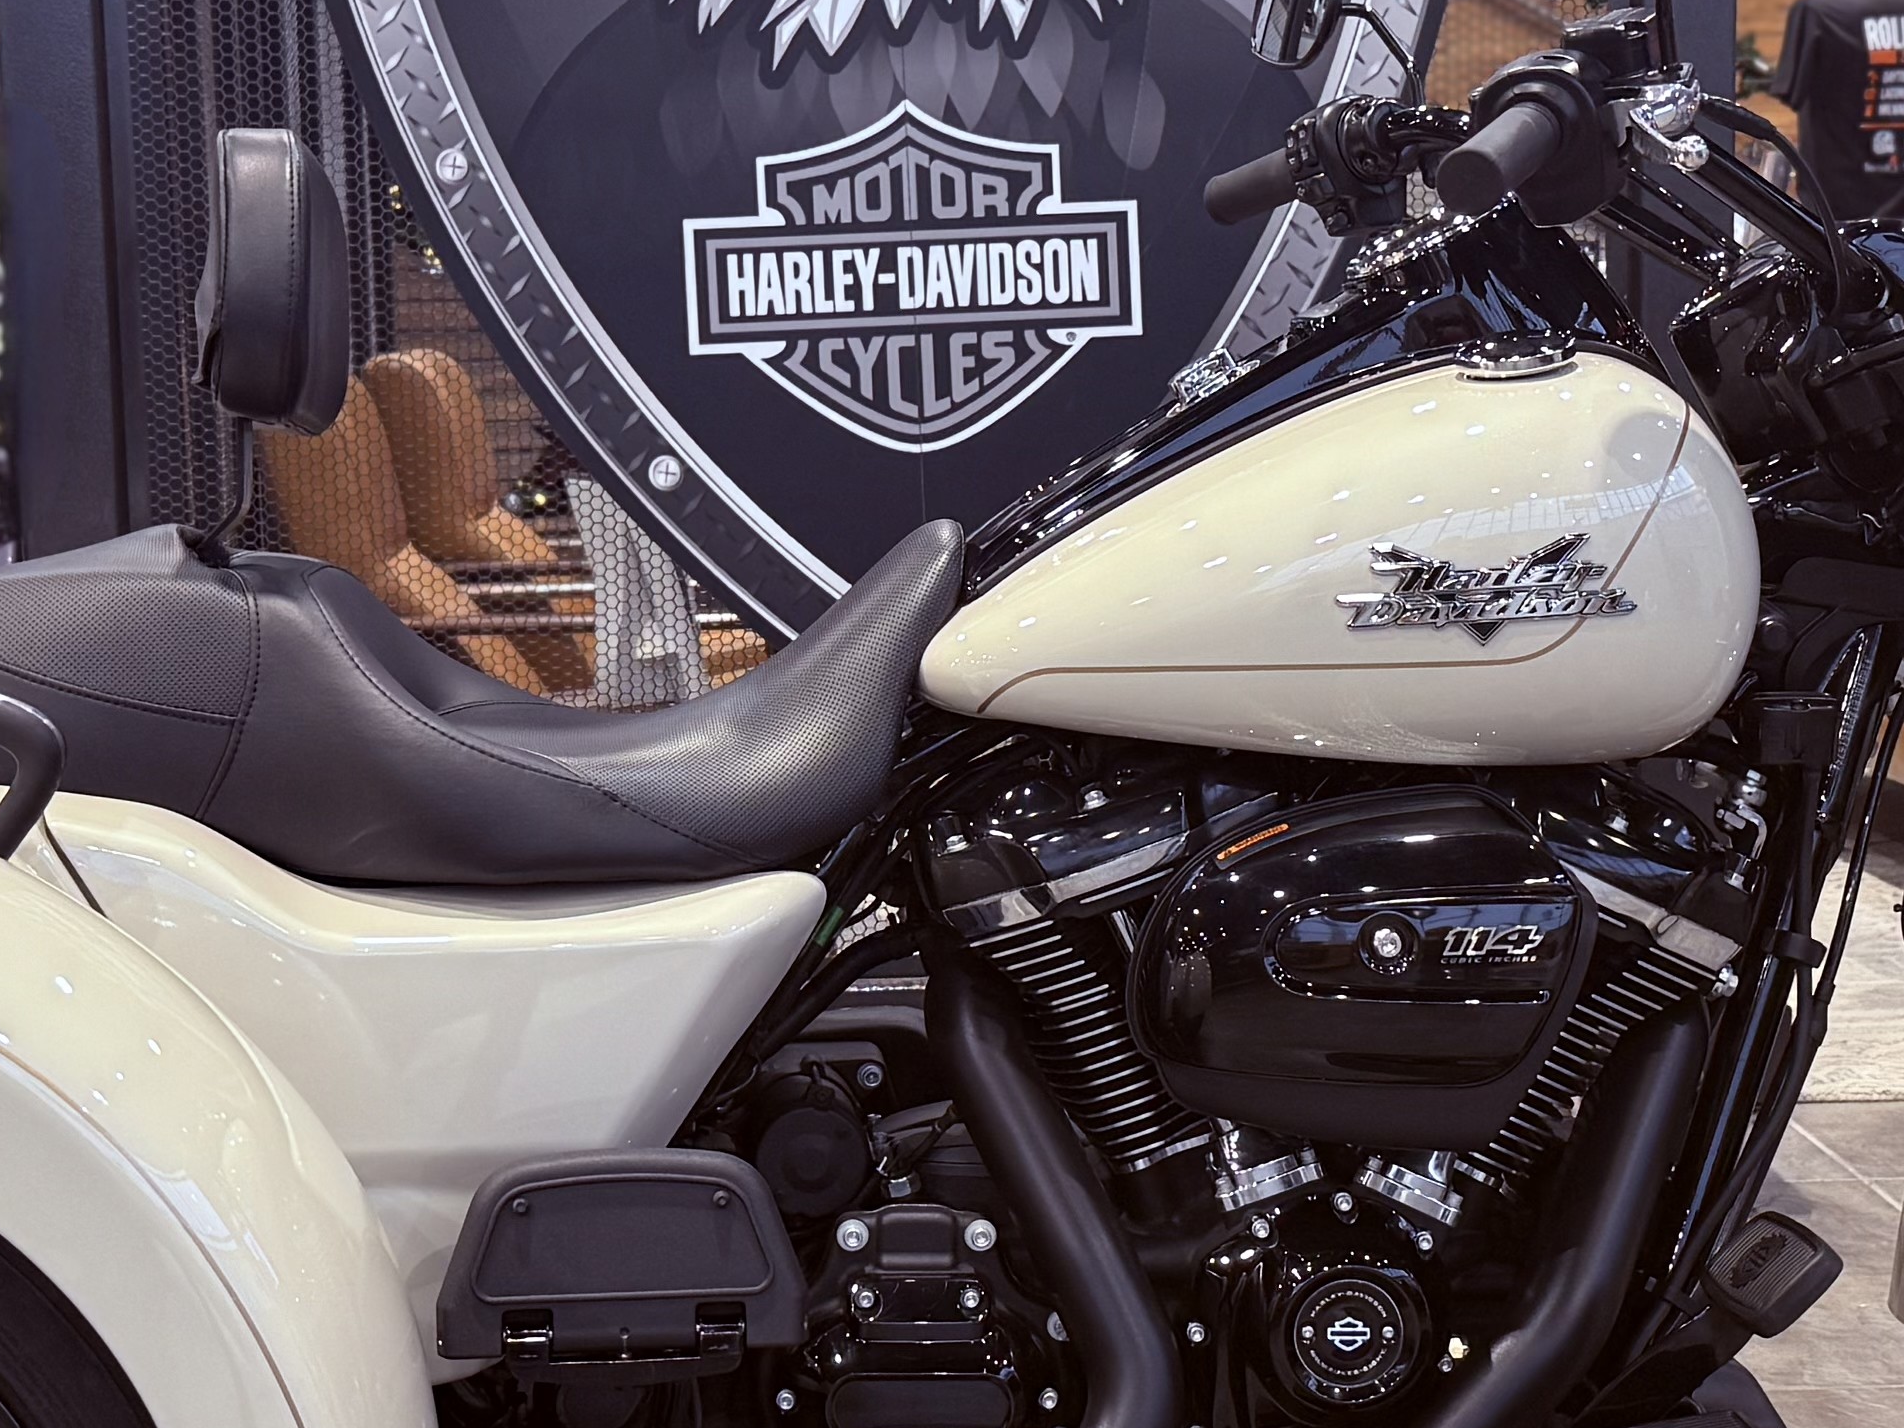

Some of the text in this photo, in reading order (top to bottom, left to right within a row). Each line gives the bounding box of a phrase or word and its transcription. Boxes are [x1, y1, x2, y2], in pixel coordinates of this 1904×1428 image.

[812, 146, 1009, 224] MOTOR
[726, 238, 1100, 318] HARLEY-DAVIDSON
[818, 329, 1015, 418] CYCLES
[1440, 956, 1483, 964] CUBIC
[1442, 925, 1544, 956] 114
[1310, 1289, 1387, 1318] HARLEY-DAVIDSON
